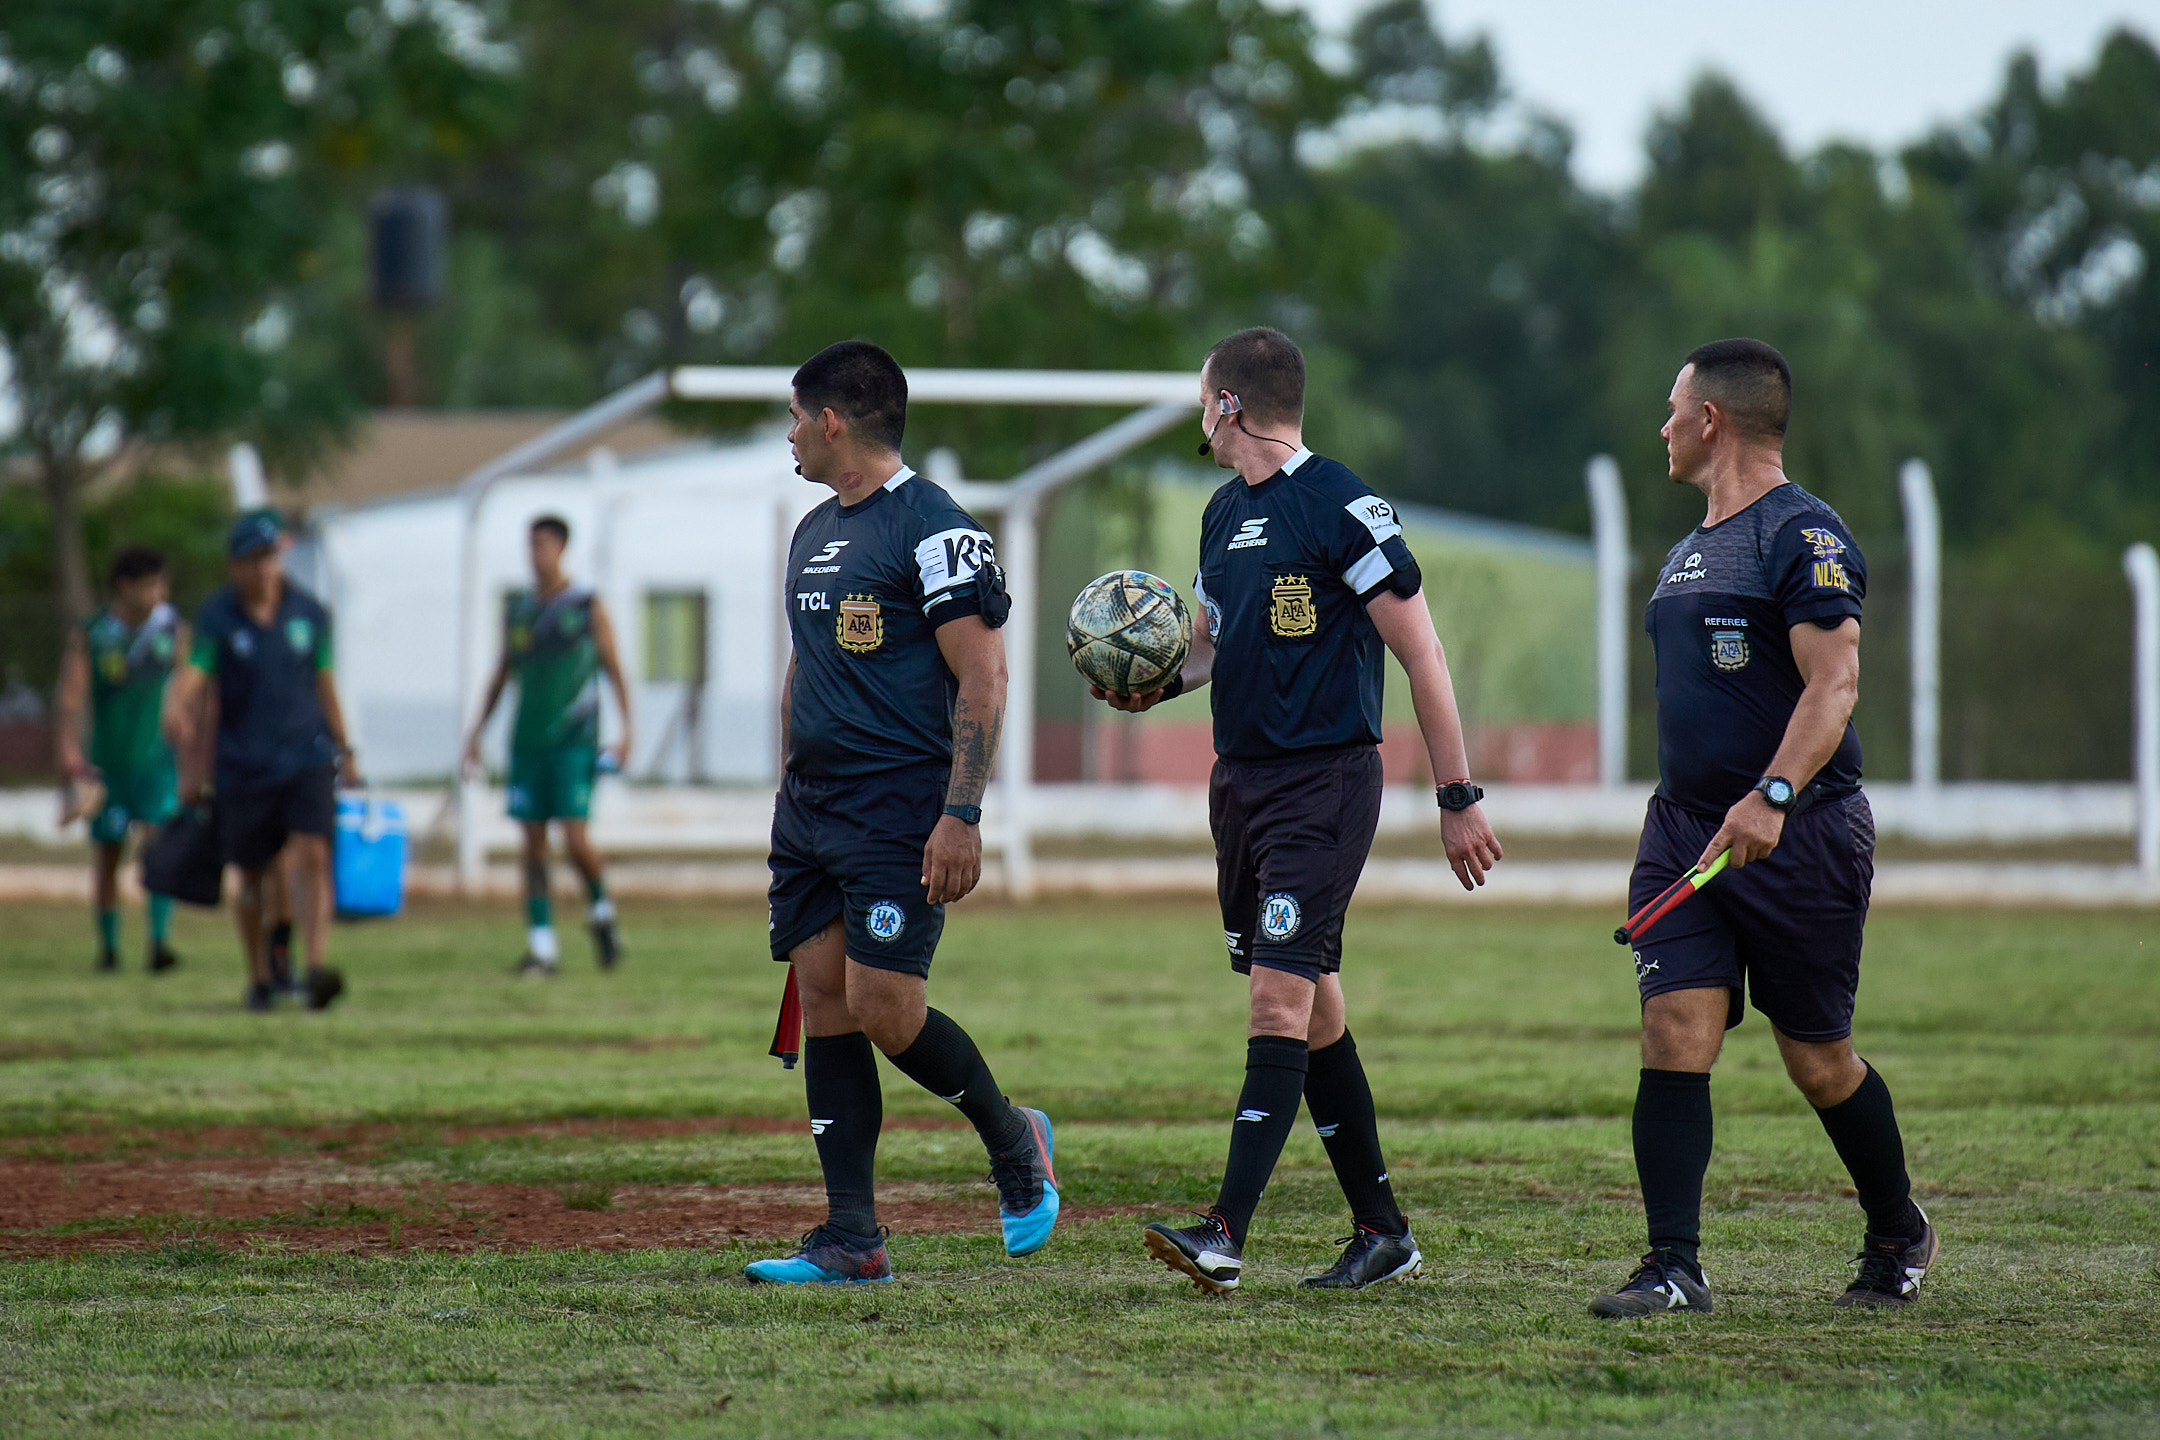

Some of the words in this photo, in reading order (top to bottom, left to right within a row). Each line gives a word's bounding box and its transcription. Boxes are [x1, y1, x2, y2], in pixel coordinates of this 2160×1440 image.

[1227, 538, 1268, 551] SKECHERS
[801, 565, 841, 574] SKECHERS
[1667, 568, 1707, 584] ATHIX
[797, 592, 830, 611] TCL
[1281, 598, 1307, 622] AFA
[848, 614, 873, 635] AFA
[1705, 617, 1748, 627] REFEREE
[1719, 641, 1742, 658] AFA
